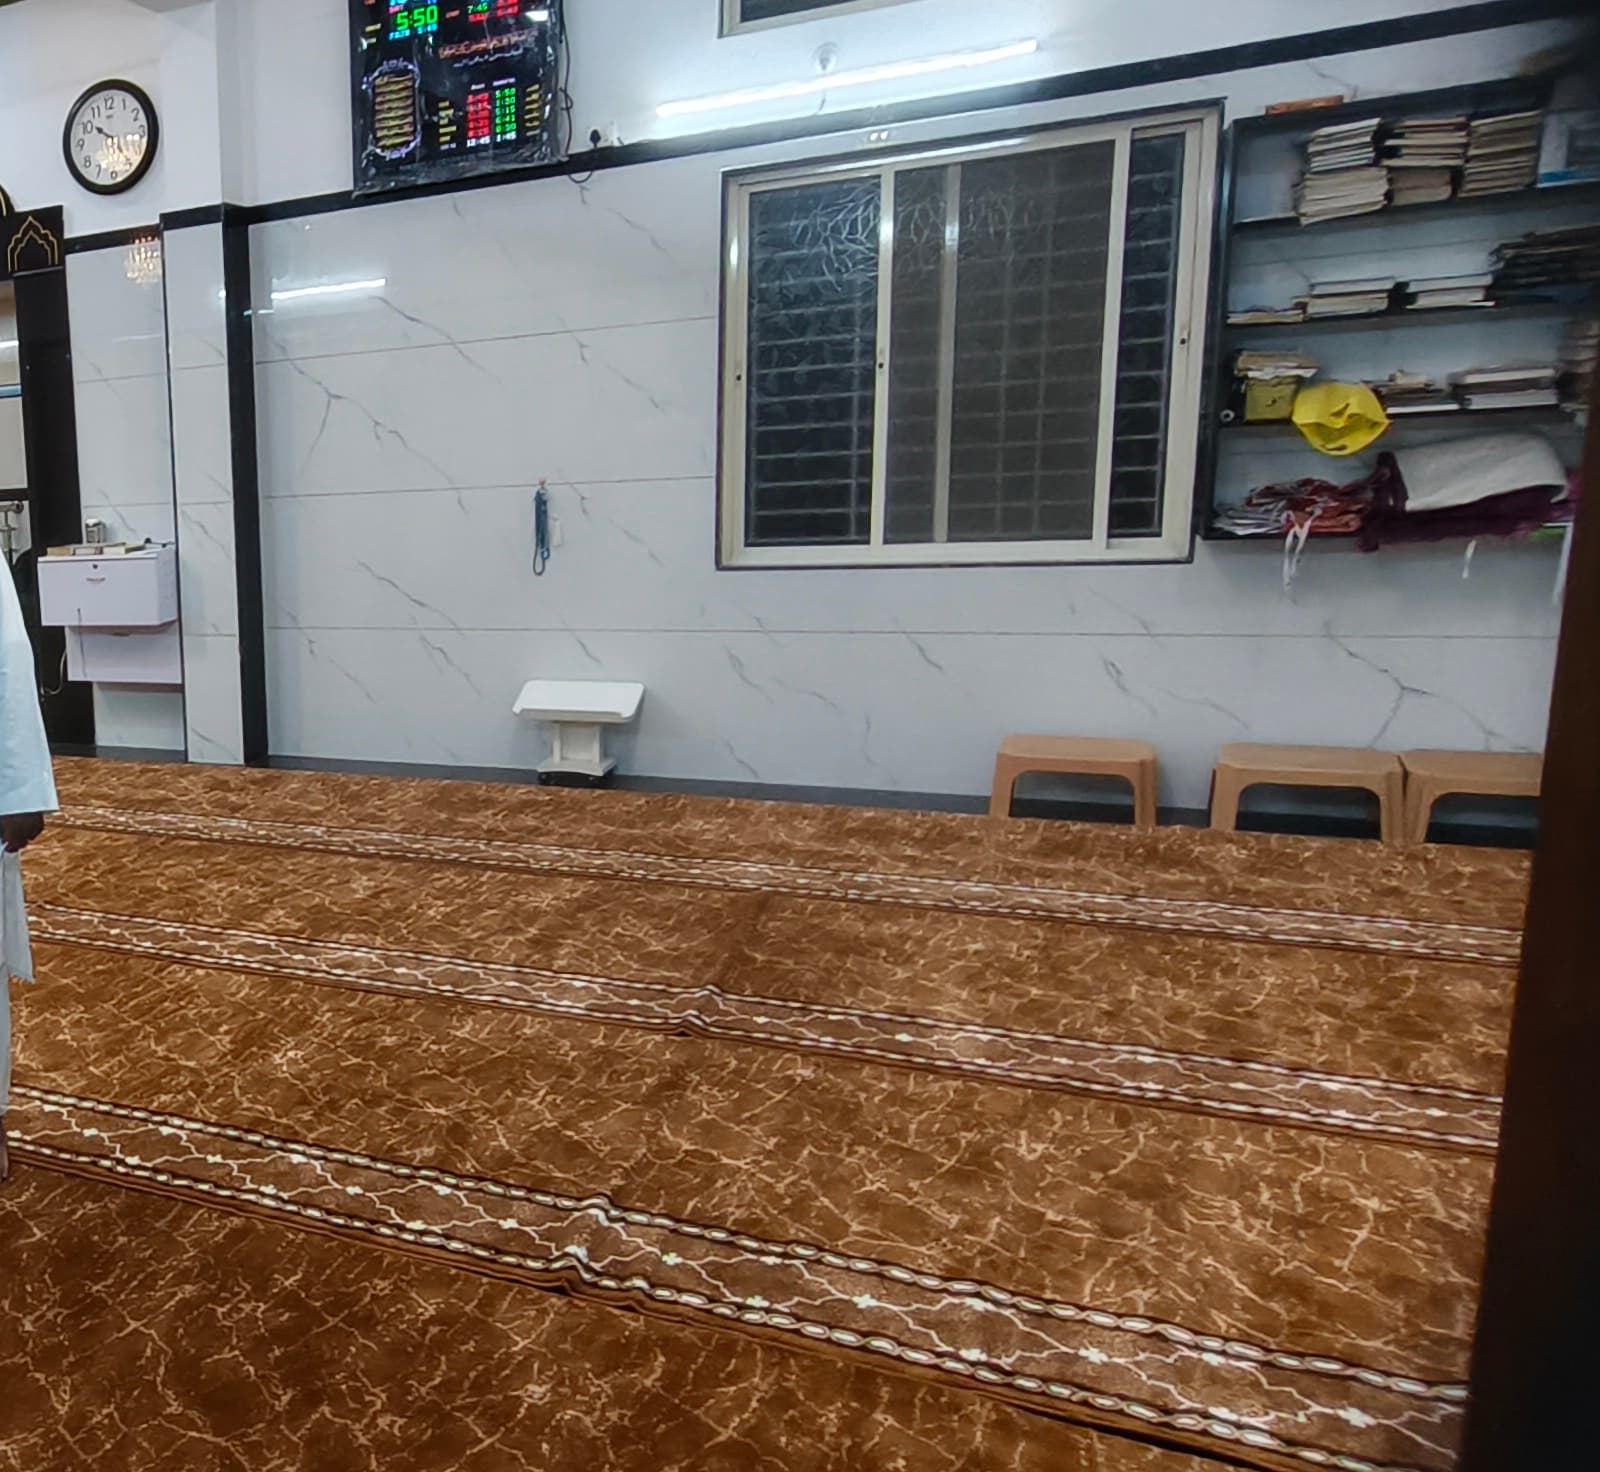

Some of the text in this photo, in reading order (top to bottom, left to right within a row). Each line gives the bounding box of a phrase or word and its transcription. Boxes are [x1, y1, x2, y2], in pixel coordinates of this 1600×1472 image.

[396, 5, 438, 31] 5:50
[104, 96, 115, 110] 12
[121, 98, 126, 111] 1
[91, 104, 101, 119] 11
[131, 107, 140, 122] 2
[82, 120, 94, 135] 10
[138, 124, 146, 138] 3
[77, 138, 85, 151] 9
[83, 155, 92, 169] 8
